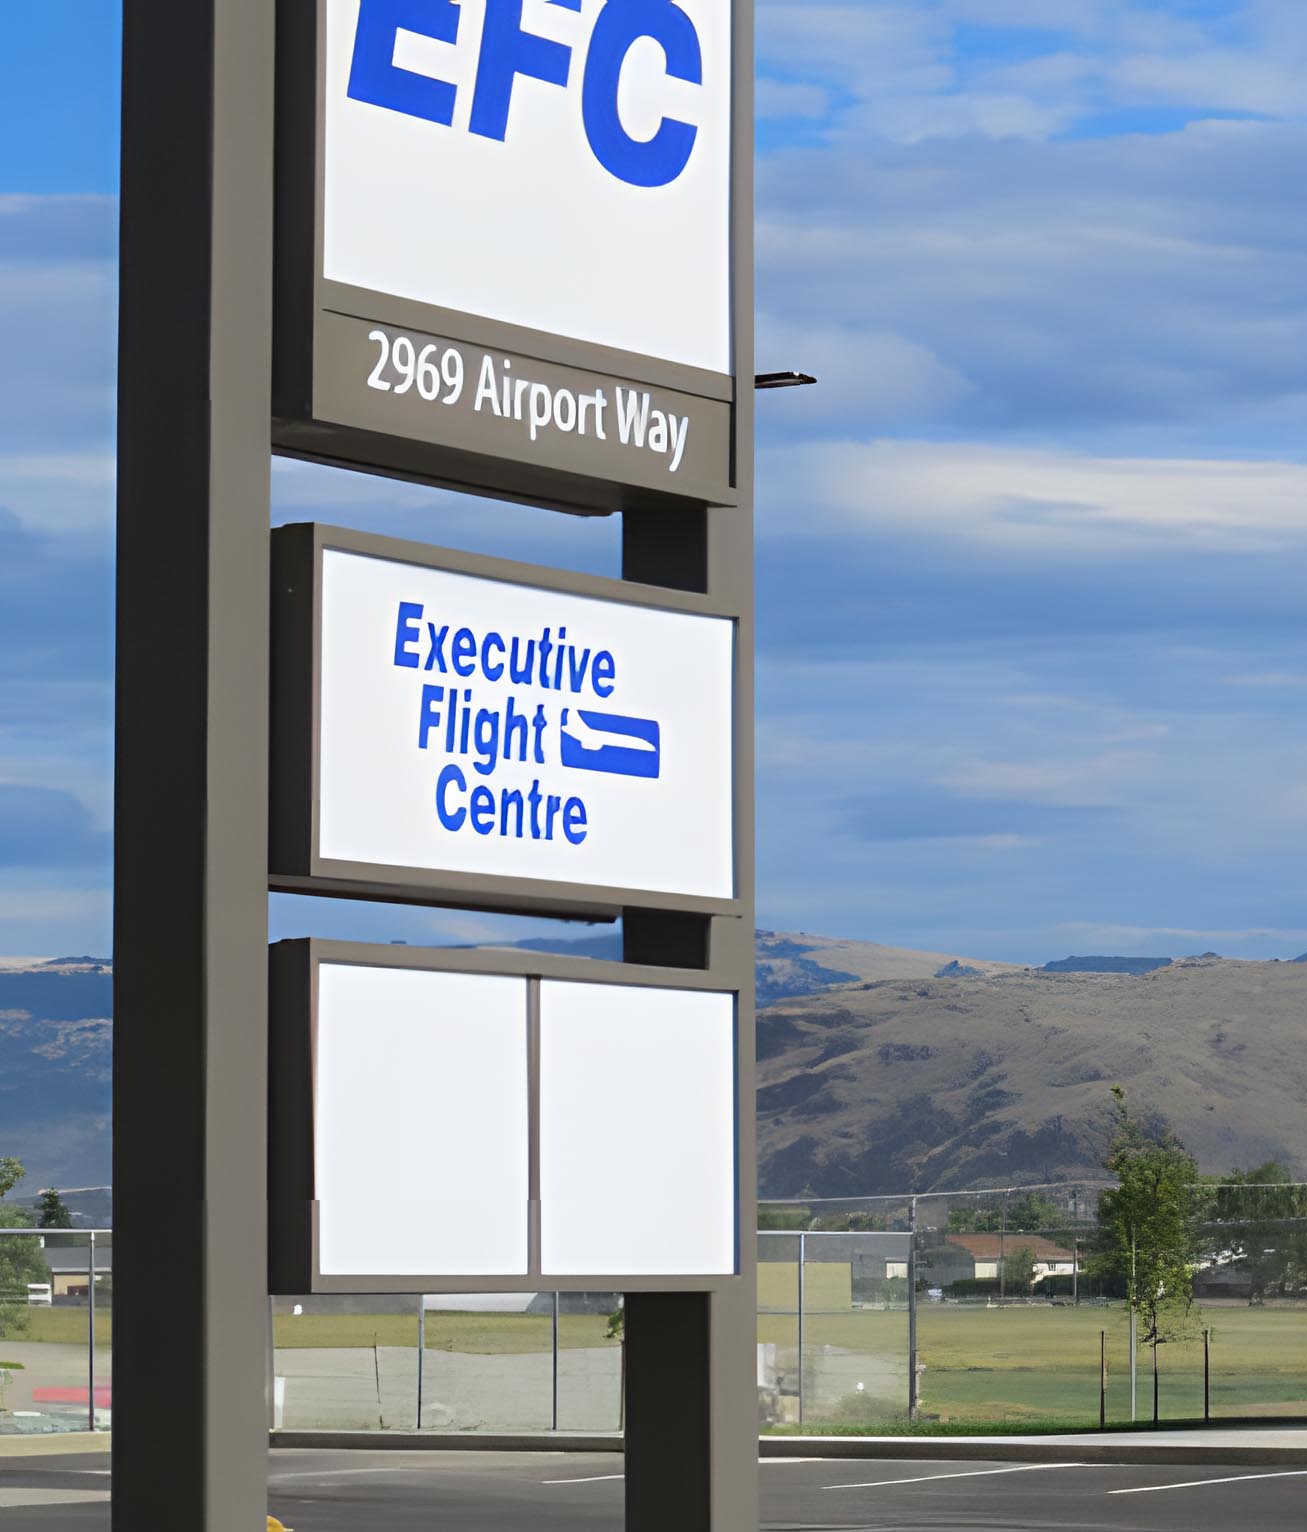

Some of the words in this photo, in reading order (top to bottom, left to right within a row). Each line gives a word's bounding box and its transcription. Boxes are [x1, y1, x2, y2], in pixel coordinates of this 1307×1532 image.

[346, 0, 703, 188] EFC
[366, 329, 465, 406] 2969
[473, 353, 608, 442] Airport
[614, 385, 690, 473] Way
[393, 601, 616, 699] Executive
[418, 683, 548, 776] Flight
[435, 763, 588, 846] Centre
